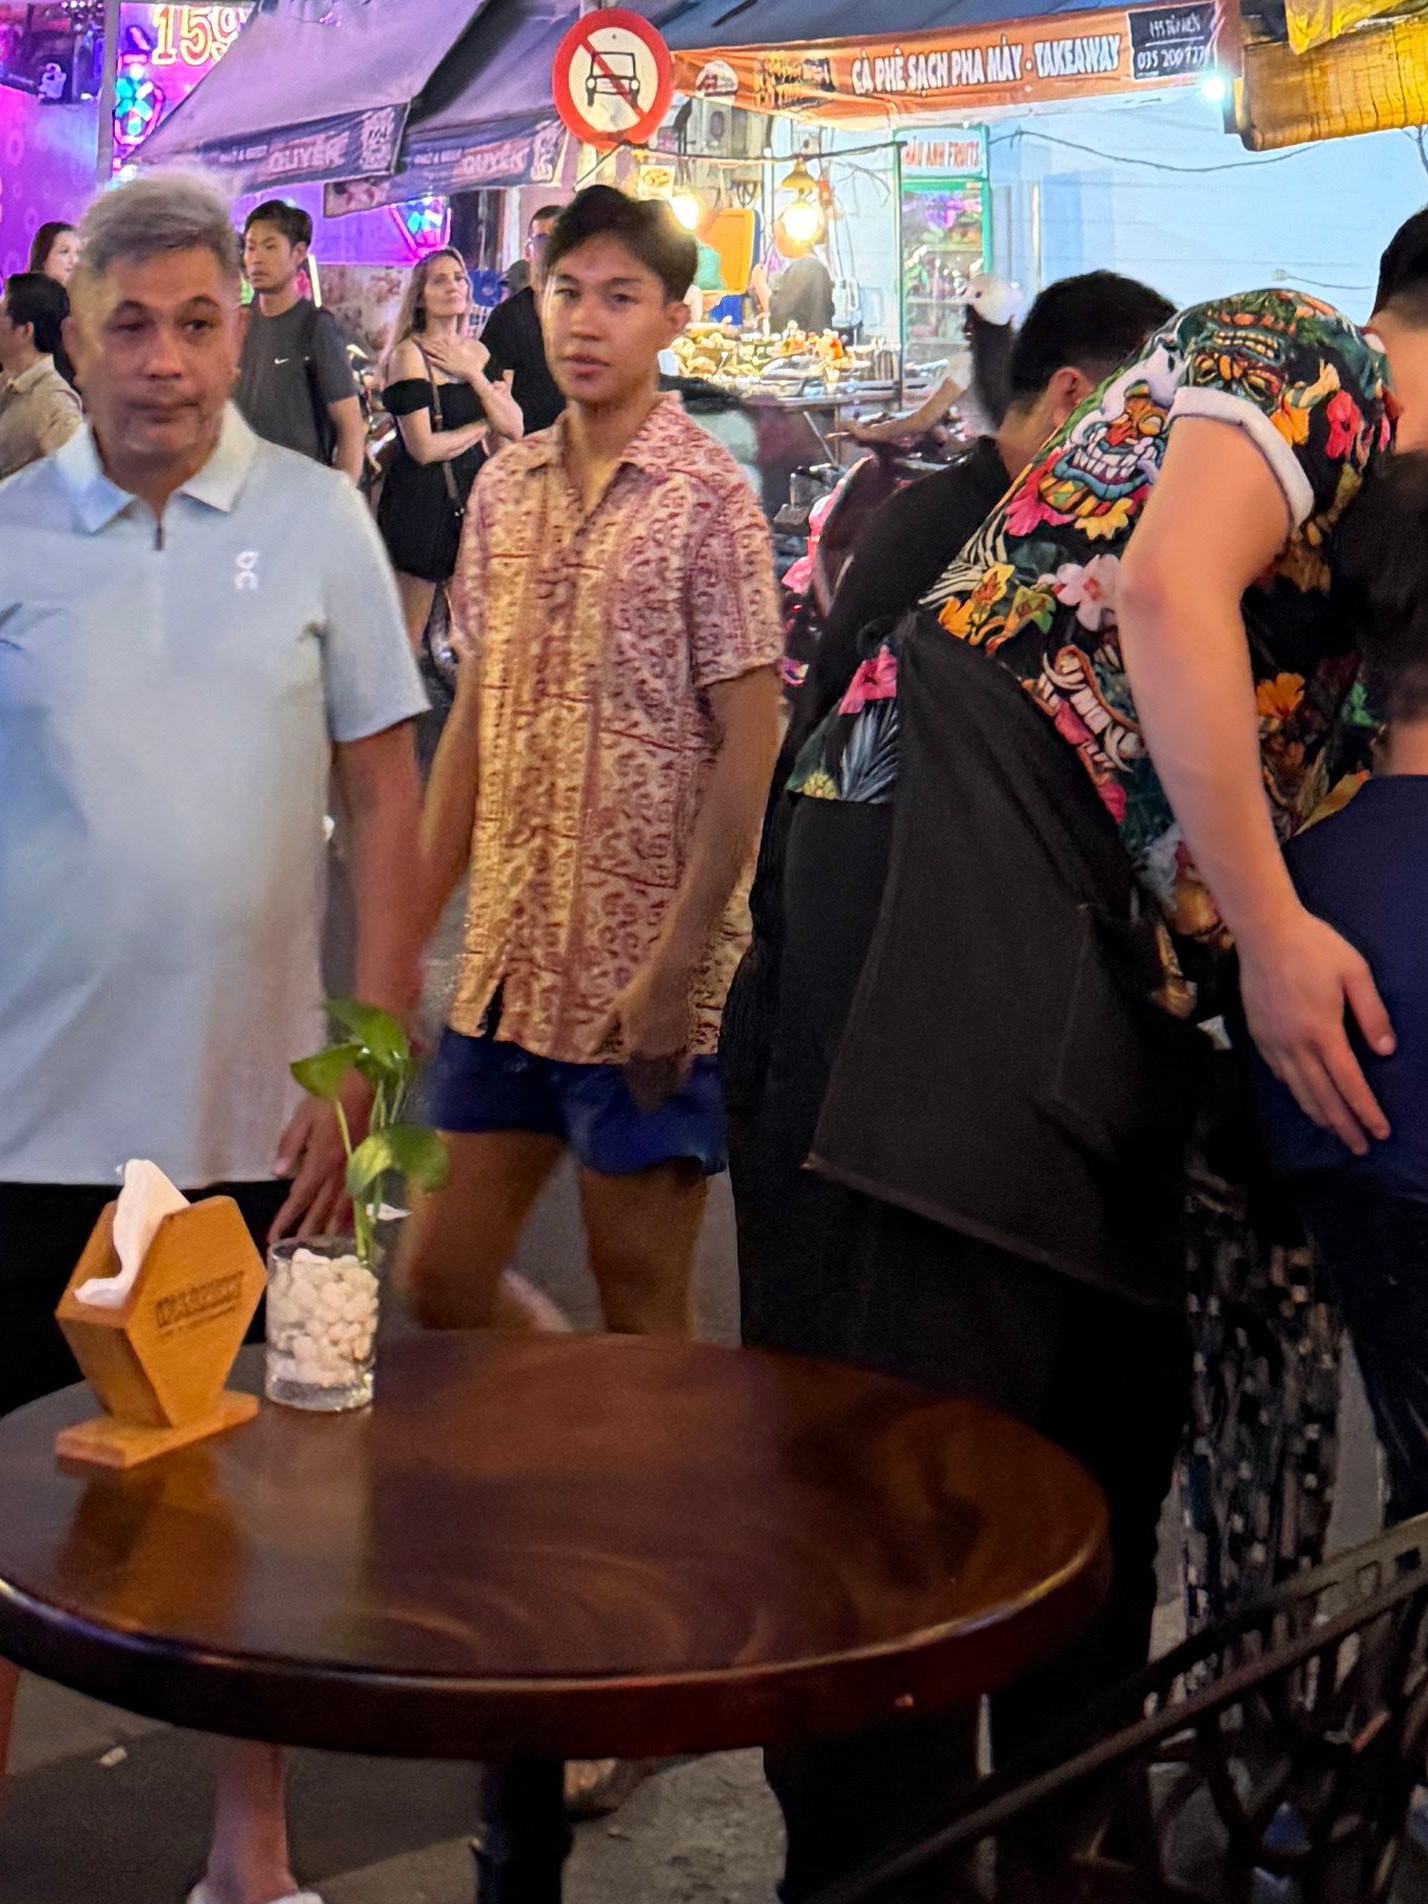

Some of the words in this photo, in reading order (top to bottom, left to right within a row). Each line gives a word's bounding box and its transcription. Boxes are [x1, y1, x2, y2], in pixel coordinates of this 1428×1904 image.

[874, 46, 906, 92] PHÊ
[951, 47, 985, 86] PHA
[1033, 34, 1121, 79] TAKEAWAY
